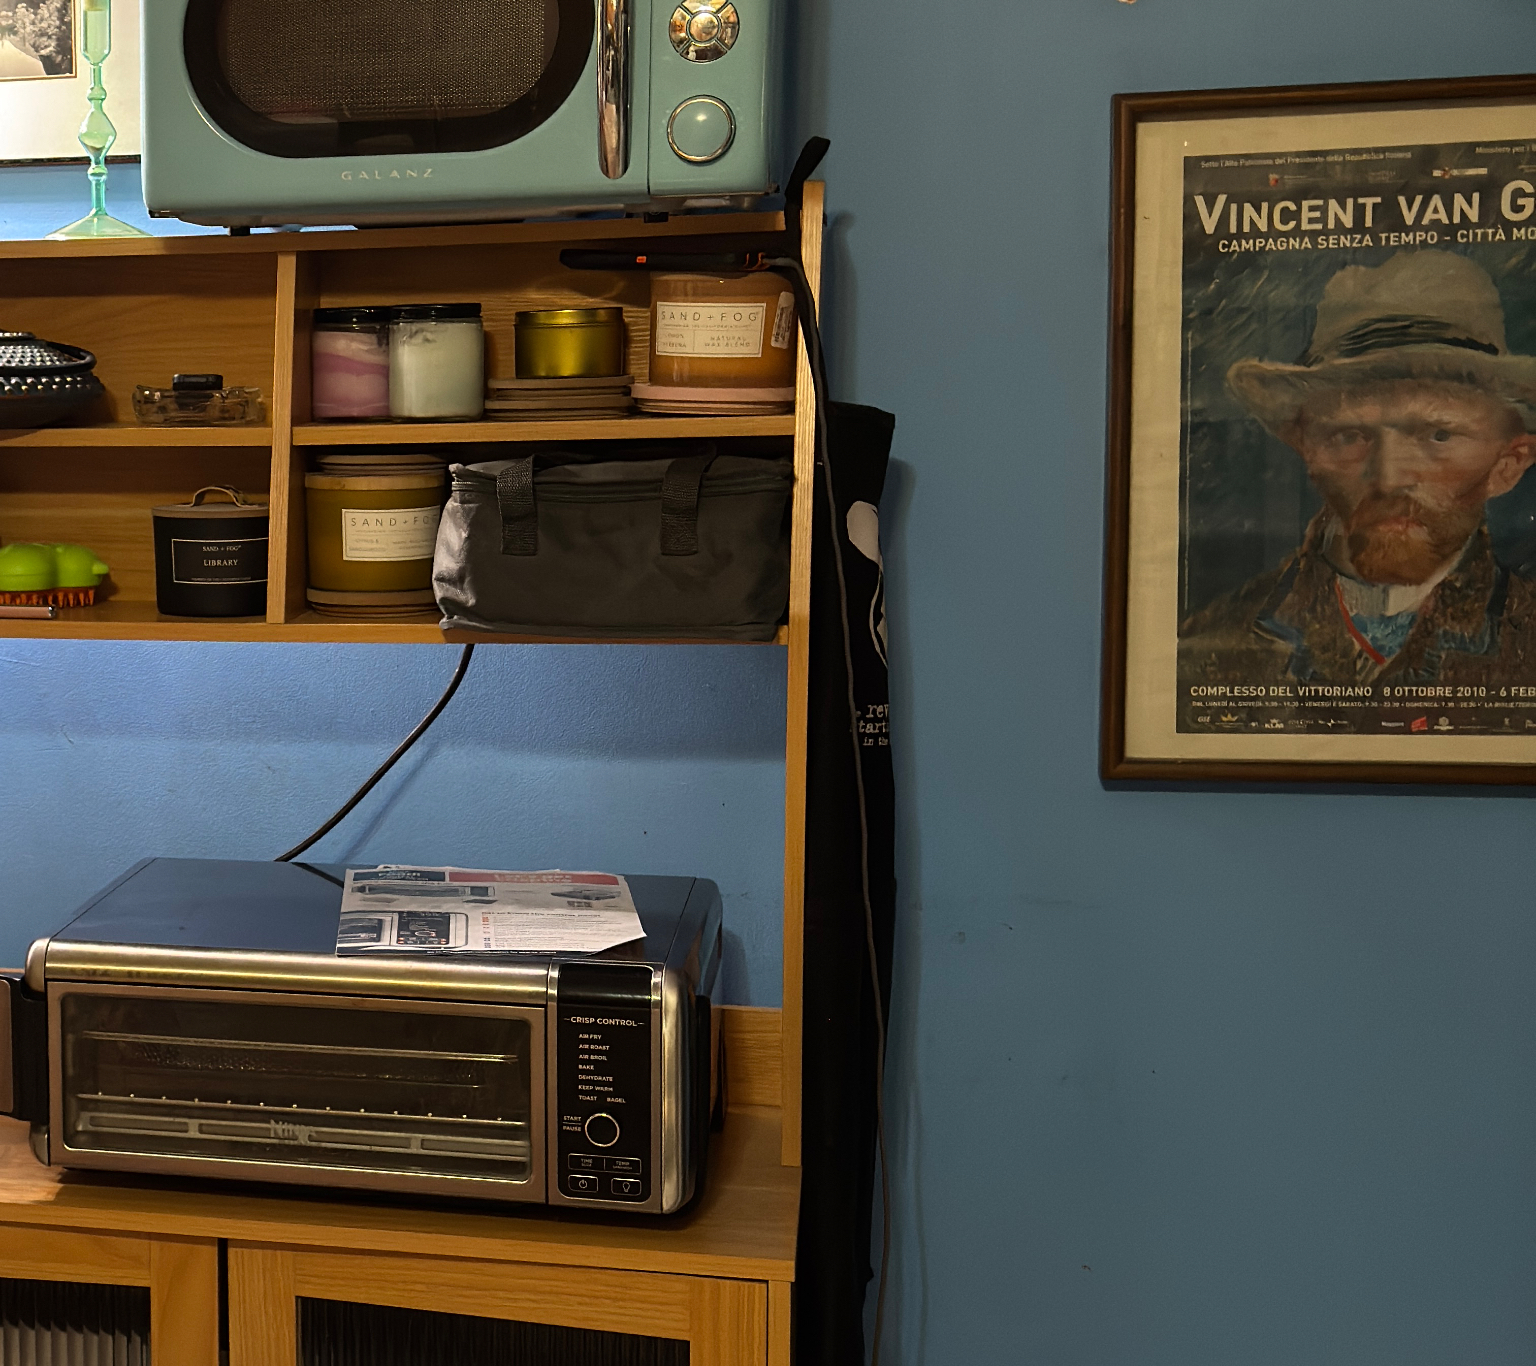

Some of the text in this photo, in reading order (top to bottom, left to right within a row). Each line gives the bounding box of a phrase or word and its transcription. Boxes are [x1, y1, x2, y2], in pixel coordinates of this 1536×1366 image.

[341, 168, 433, 181] GALANZ
[1218, 236, 1312, 253] CAMPAGNA
[1317, 233, 1373, 250] SENZA
[1380, 231, 1438, 247] TEMPO
[1456, 225, 1506, 243] CITTÀ
[661, 311, 701, 322] SAND
[720, 312, 757, 322] FOG
[351, 517, 397, 527] SAND
[203, 559, 239, 567] LIBRARY
[1190, 686, 1265, 697] COMPLESSO
[1269, 686, 1294, 697] DEL
[1297, 686, 1373, 697] VITTORIANO
[1383, 686, 1391, 697] 8
[1394, 686, 1453, 697] OTTOBRE
[1457, 686, 1487, 697] 2010
[1499, 686, 1507, 697] 6
[570, 1016, 638, 1027] CRISP CONTROL
